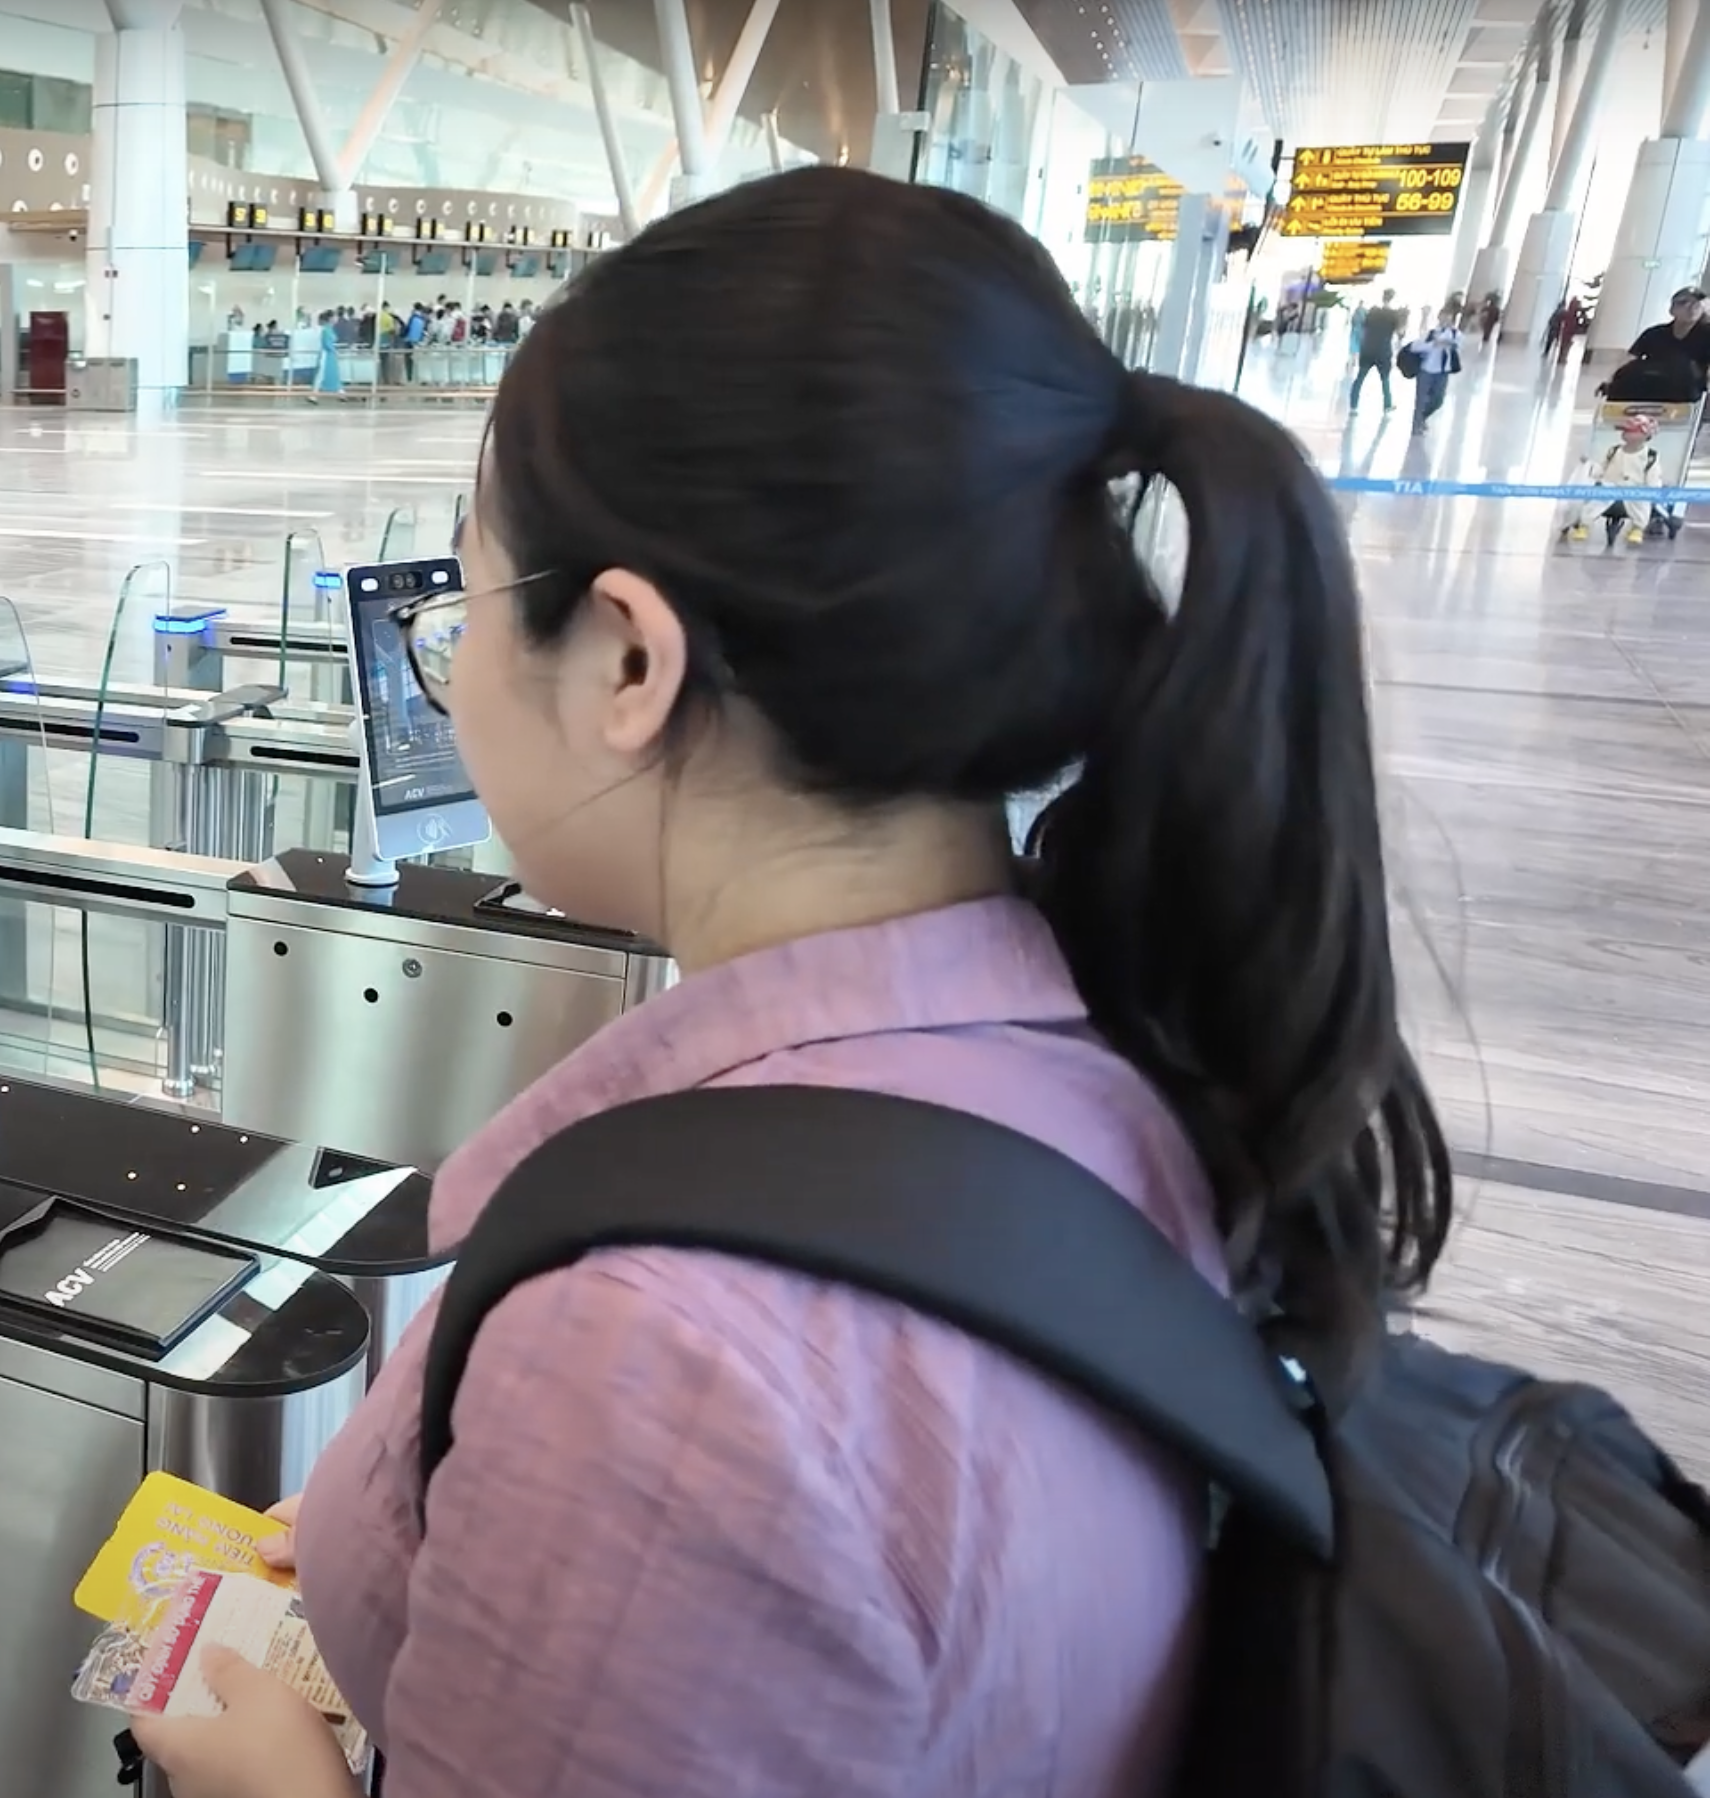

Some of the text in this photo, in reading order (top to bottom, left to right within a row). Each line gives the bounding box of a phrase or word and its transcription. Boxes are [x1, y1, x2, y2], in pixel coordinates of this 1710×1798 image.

[1399, 168, 1461, 188] 100-109
[1394, 480, 1423, 495] TIA
[44, 1267, 95, 1307] ACV
